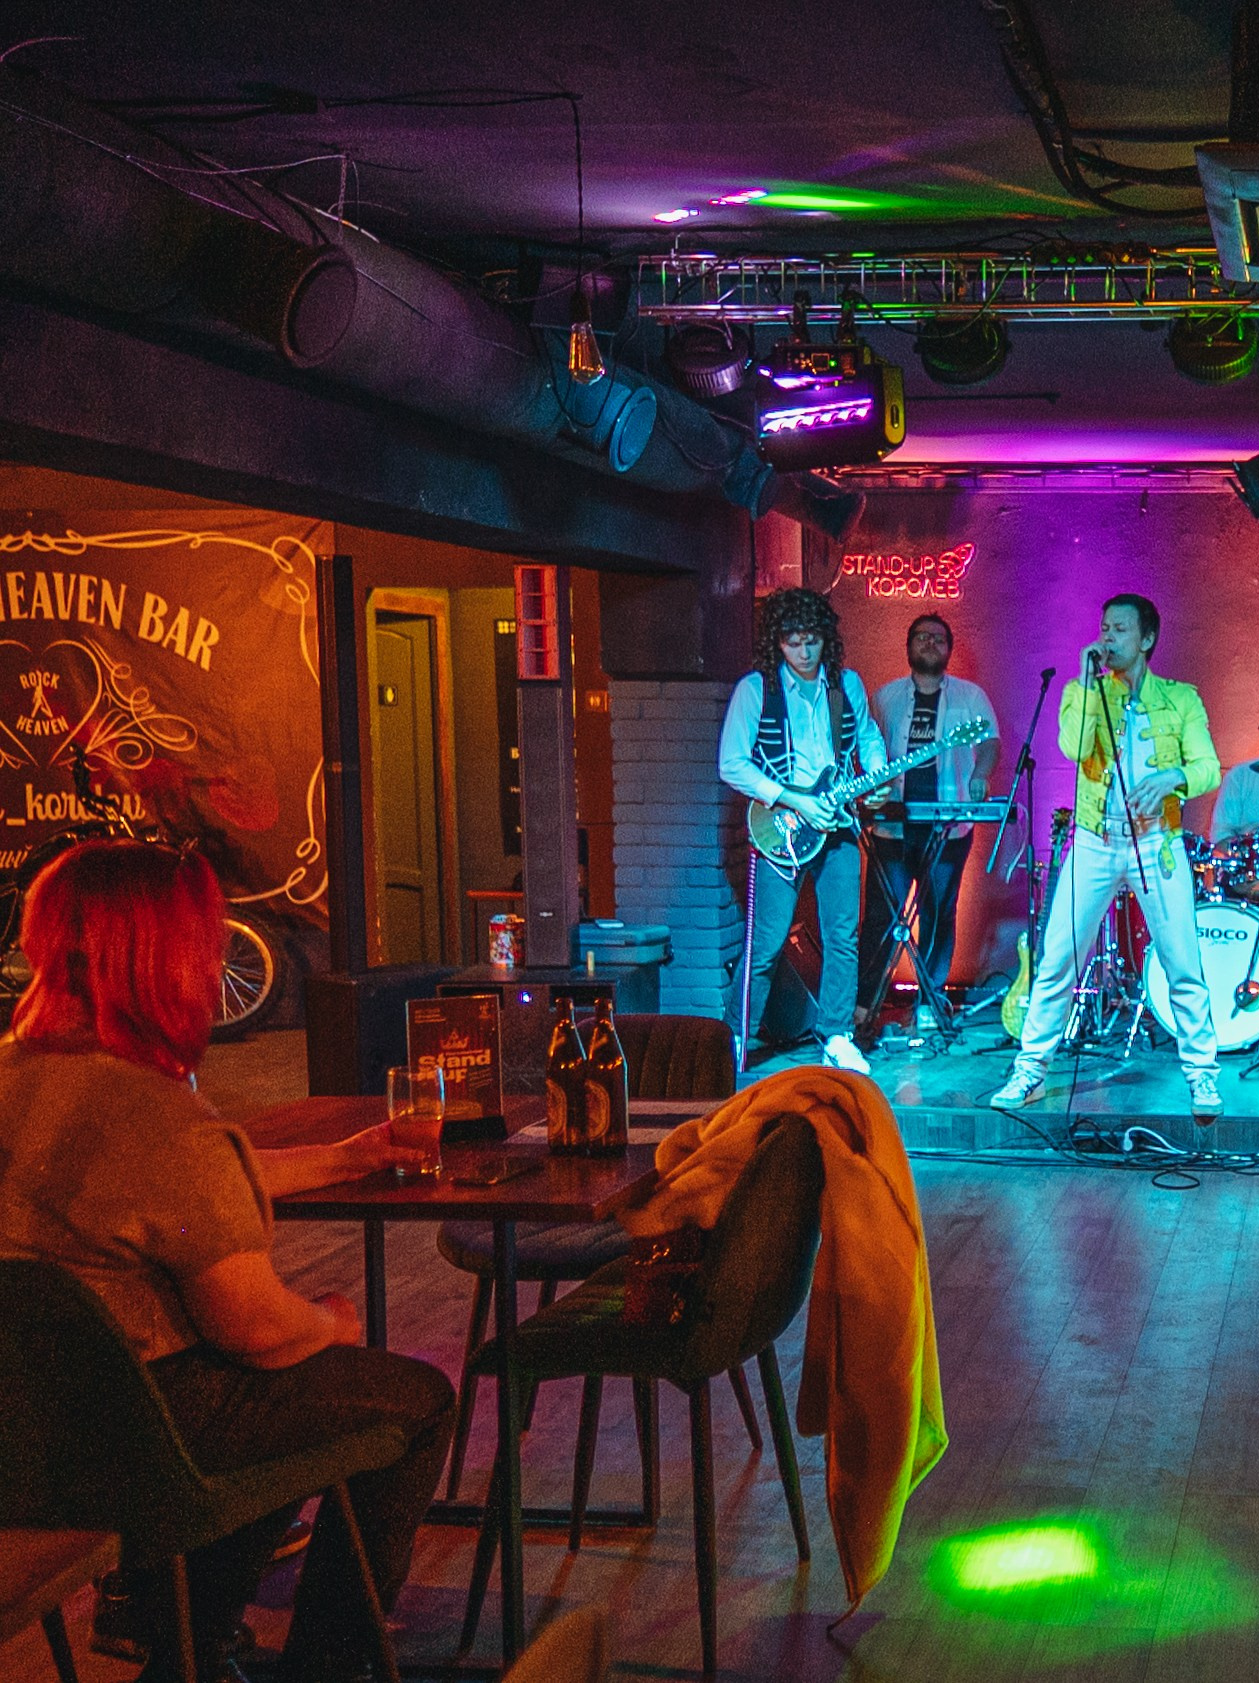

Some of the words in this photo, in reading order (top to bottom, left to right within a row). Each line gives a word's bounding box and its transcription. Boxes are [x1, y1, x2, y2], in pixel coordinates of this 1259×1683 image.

[842, 555, 935, 576] STAND-UP
[867, 576, 960, 598] КОРОЛЕВ
[0, 571, 127, 631] EAVEN
[138, 591, 220, 672] BAR
[16, 714, 69, 736] HEAVEN
